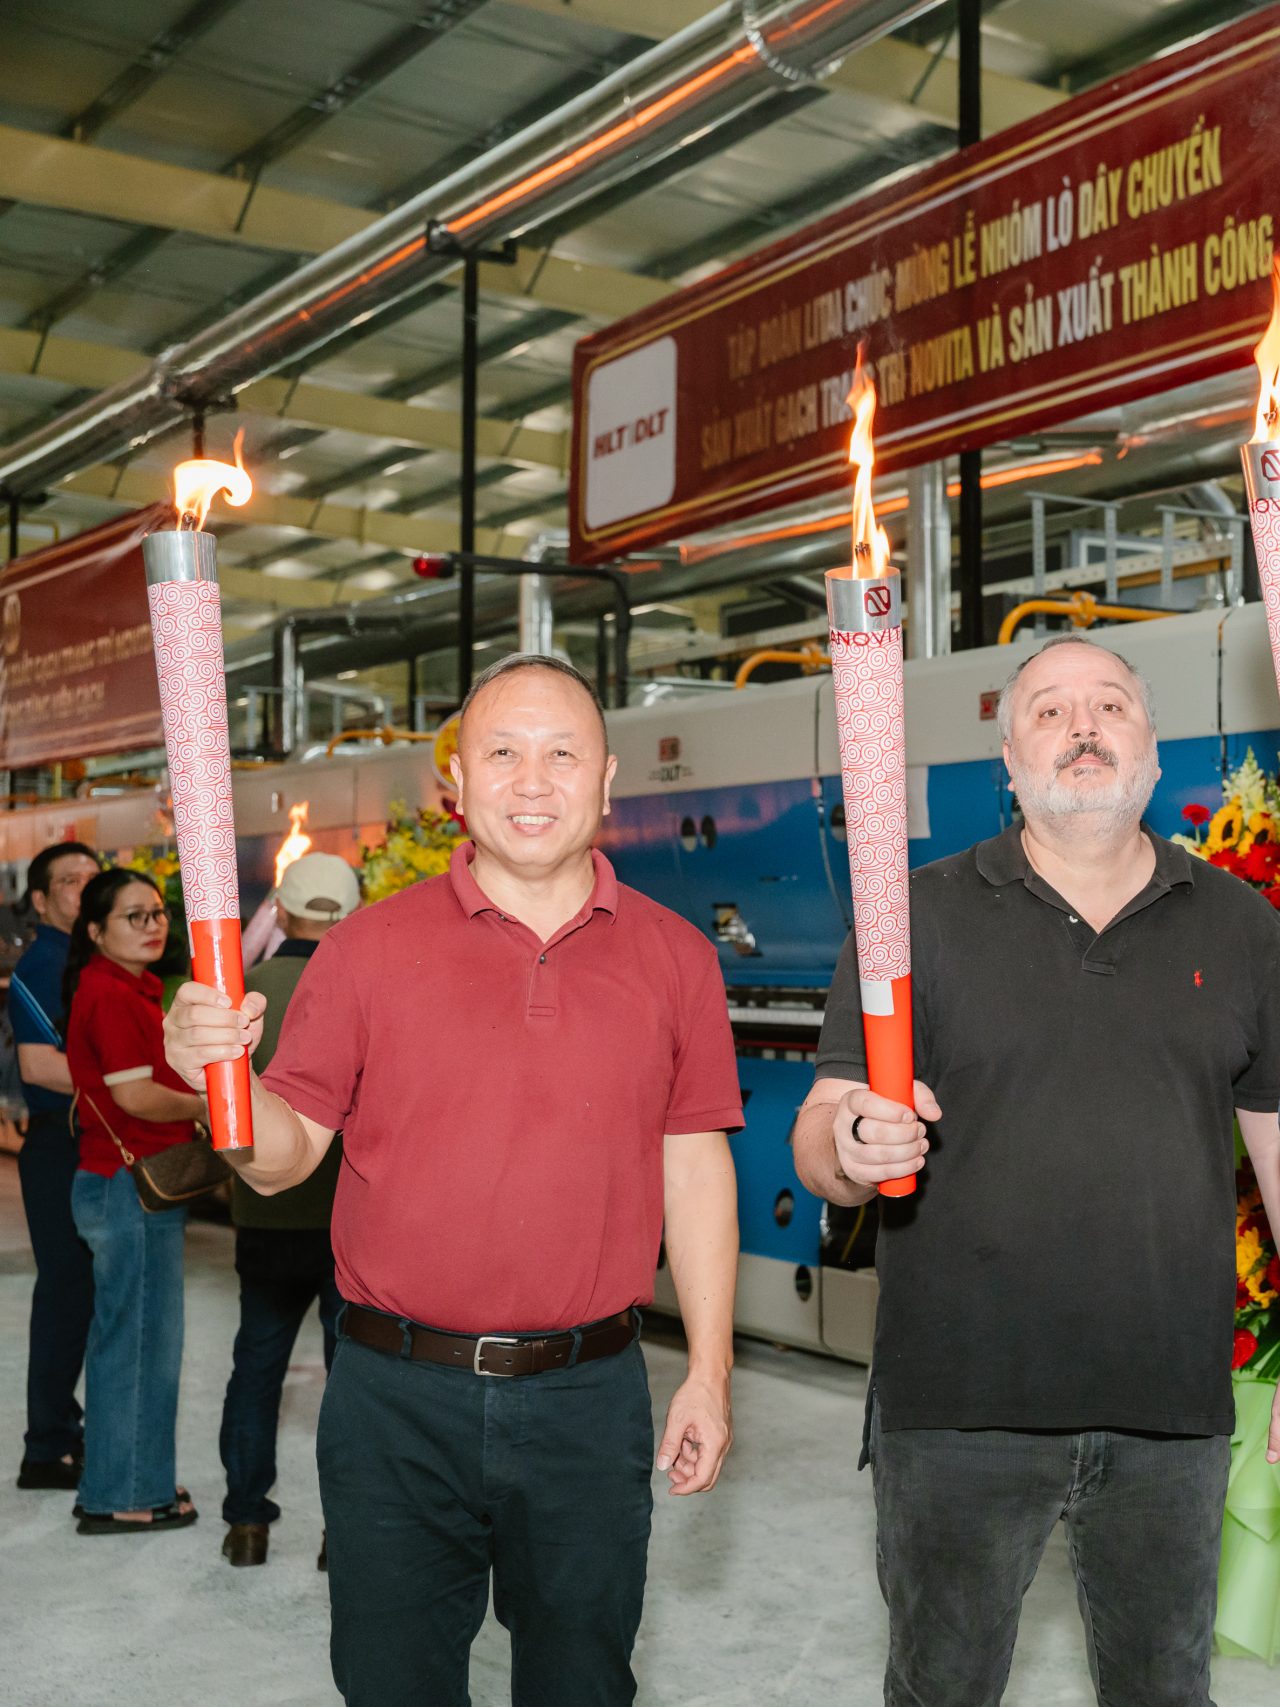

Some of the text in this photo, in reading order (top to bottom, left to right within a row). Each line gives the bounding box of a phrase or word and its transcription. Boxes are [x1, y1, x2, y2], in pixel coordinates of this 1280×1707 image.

[845, 260, 893, 333] CHÚC
[895, 241, 950, 314] MỪNG
[953, 209, 977, 289] LỄ
[980, 199, 1043, 278] NHÓM
[1046, 175, 1074, 253] LÒ
[1078, 162, 1124, 241] DÂY
[910, 325, 975, 398] NOVITA
[976, 302, 1006, 374] VÀ
[1008, 281, 1054, 364] SẢN
[1056, 255, 1115, 348] XUẤT
[1118, 243, 1199, 326] THÀNH
[1203, 213, 1274, 297] CÔNG
[634, 407, 670, 445] DLT
